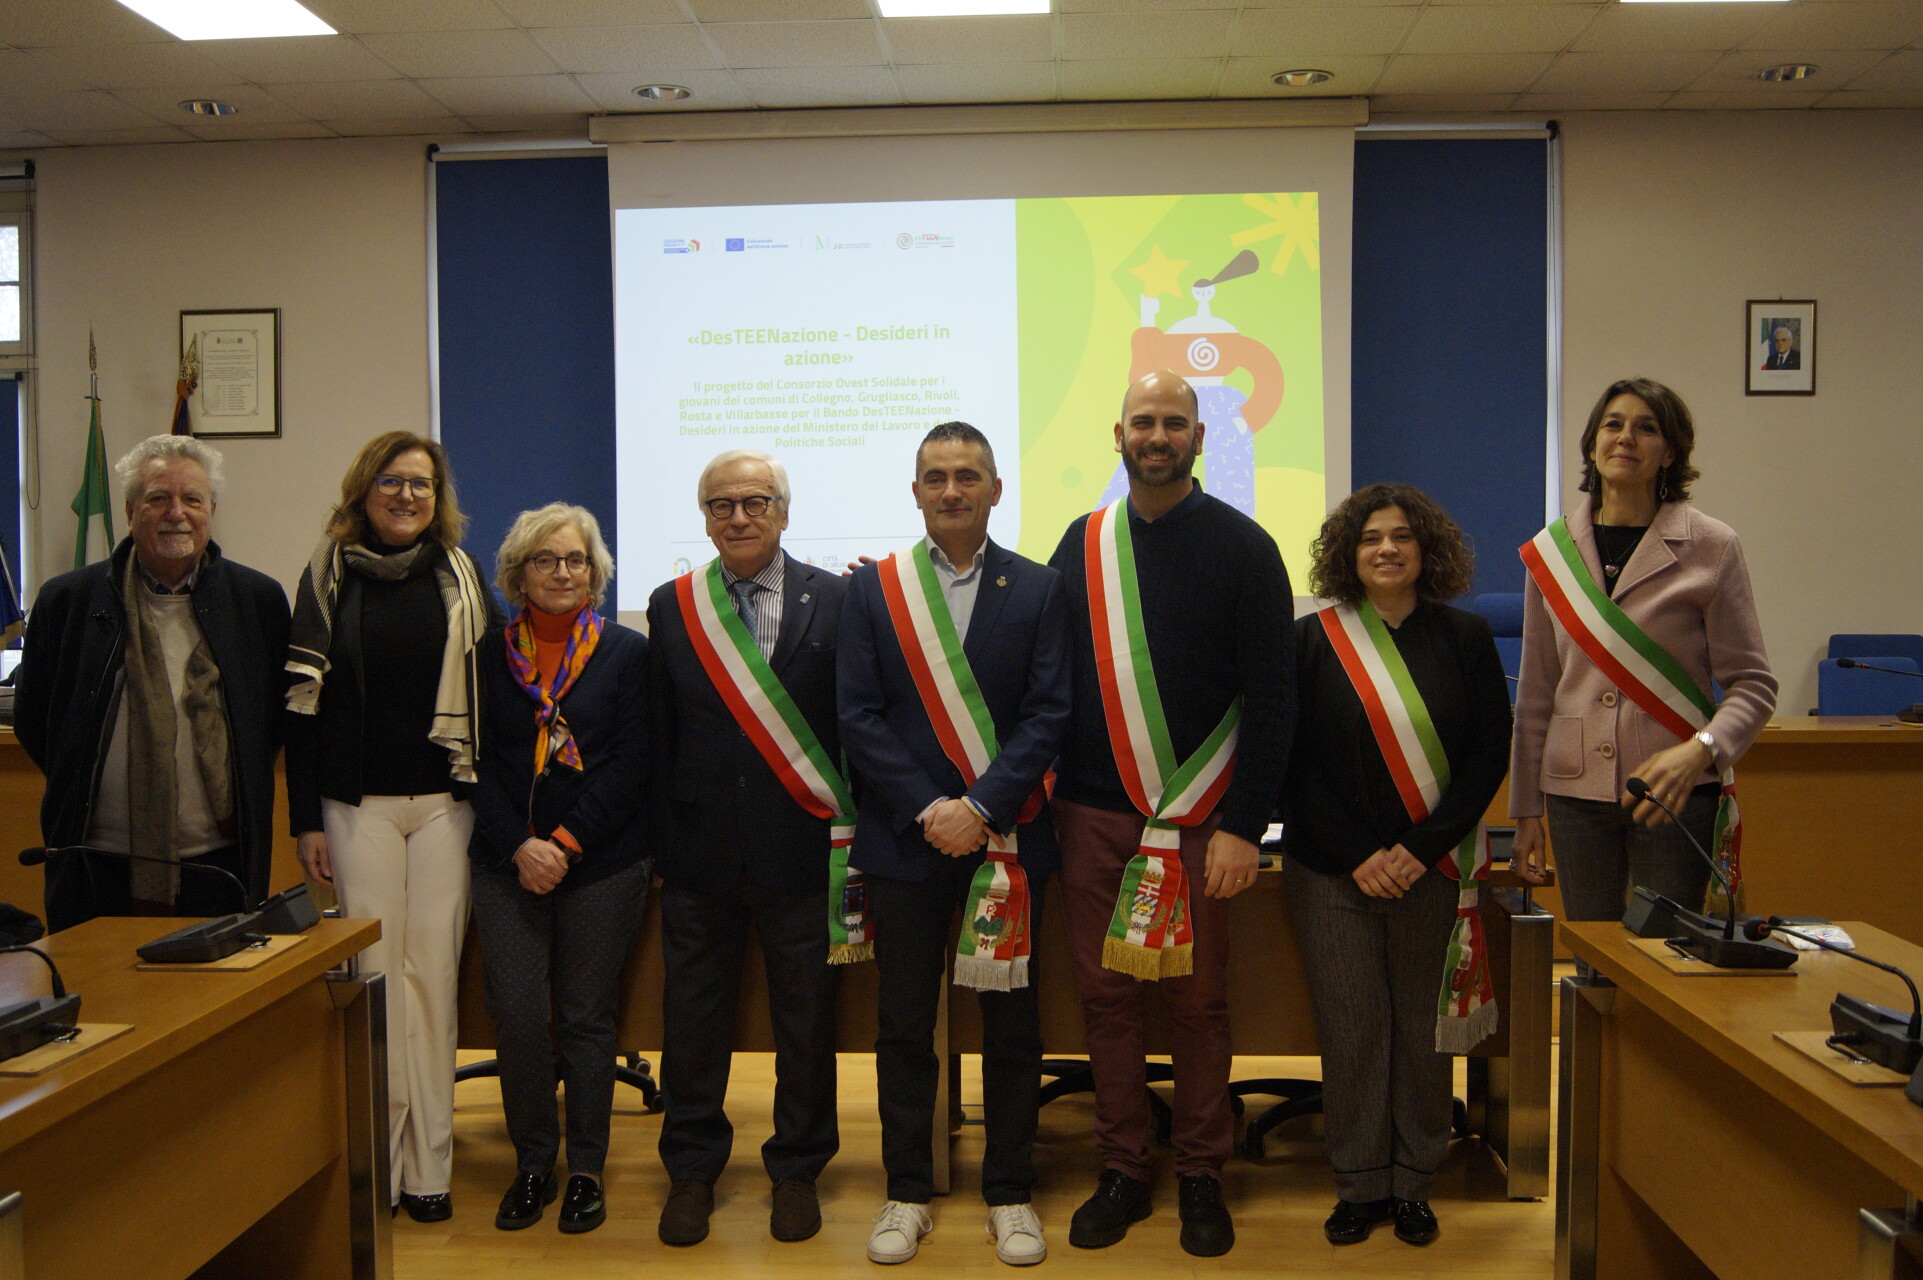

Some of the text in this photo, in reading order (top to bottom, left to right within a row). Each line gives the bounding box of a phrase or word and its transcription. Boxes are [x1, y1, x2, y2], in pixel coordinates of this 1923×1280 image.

[856, 324, 929, 341] Desideri
[934, 324, 950, 339] in
[693, 381, 701, 392] Il
[704, 380, 754, 394] progetto
[756, 379, 773, 391] del
[776, 377, 833, 390] Consorzio
[836, 377, 869, 388] Ovest
[871, 376, 917, 388] Solidale
[920, 377, 939, 389] per
[679, 389, 960, 409] giovani dei comuni di Collegno, Grugliasco, Rivoli,
[679, 410, 712, 421] Rosta
[715, 412, 722, 420] e
[725, 409, 788, 420] Villarbasse
[791, 410, 810, 422] per
[813, 407, 820, 418] il
[823, 406, 859, 417] Bando
[862, 404, 952, 416] DesTEENazione
[679, 424, 726, 436] Desideri
[728, 424, 740, 434] in
[742, 423, 780, 434] azione
[782, 422, 800, 433] del
[803, 421, 859, 432] Ministero
[861, 421, 879, 431] del
[882, 420, 920, 431] Lavoro
[923, 421, 930, 430] e
[775, 435, 865, 448] Politiche Sociali
